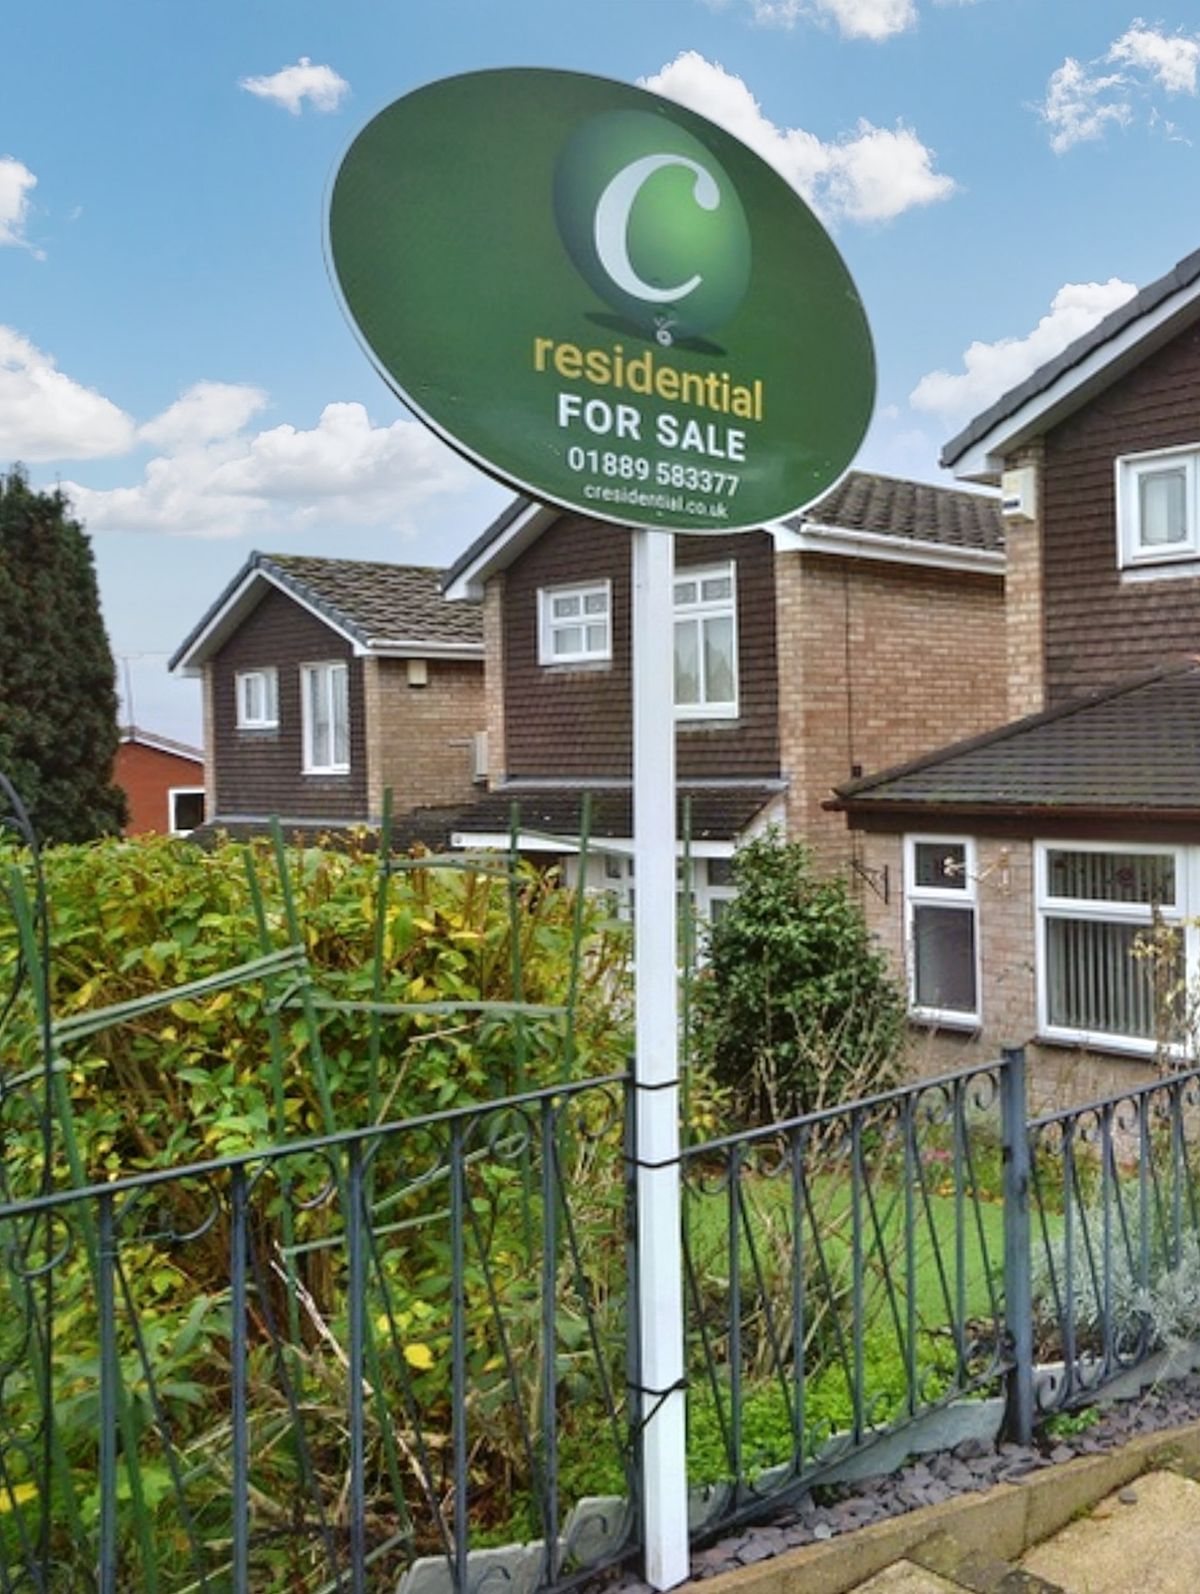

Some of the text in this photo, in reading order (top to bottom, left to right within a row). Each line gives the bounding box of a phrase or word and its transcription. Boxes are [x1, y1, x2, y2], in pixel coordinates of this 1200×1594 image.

[533, 337, 764, 421] residential
[558, 392, 747, 461] FOR SALE
[568, 446, 740, 497] 01889 583377
[583, 482, 729, 519] cresidential.co.uk
